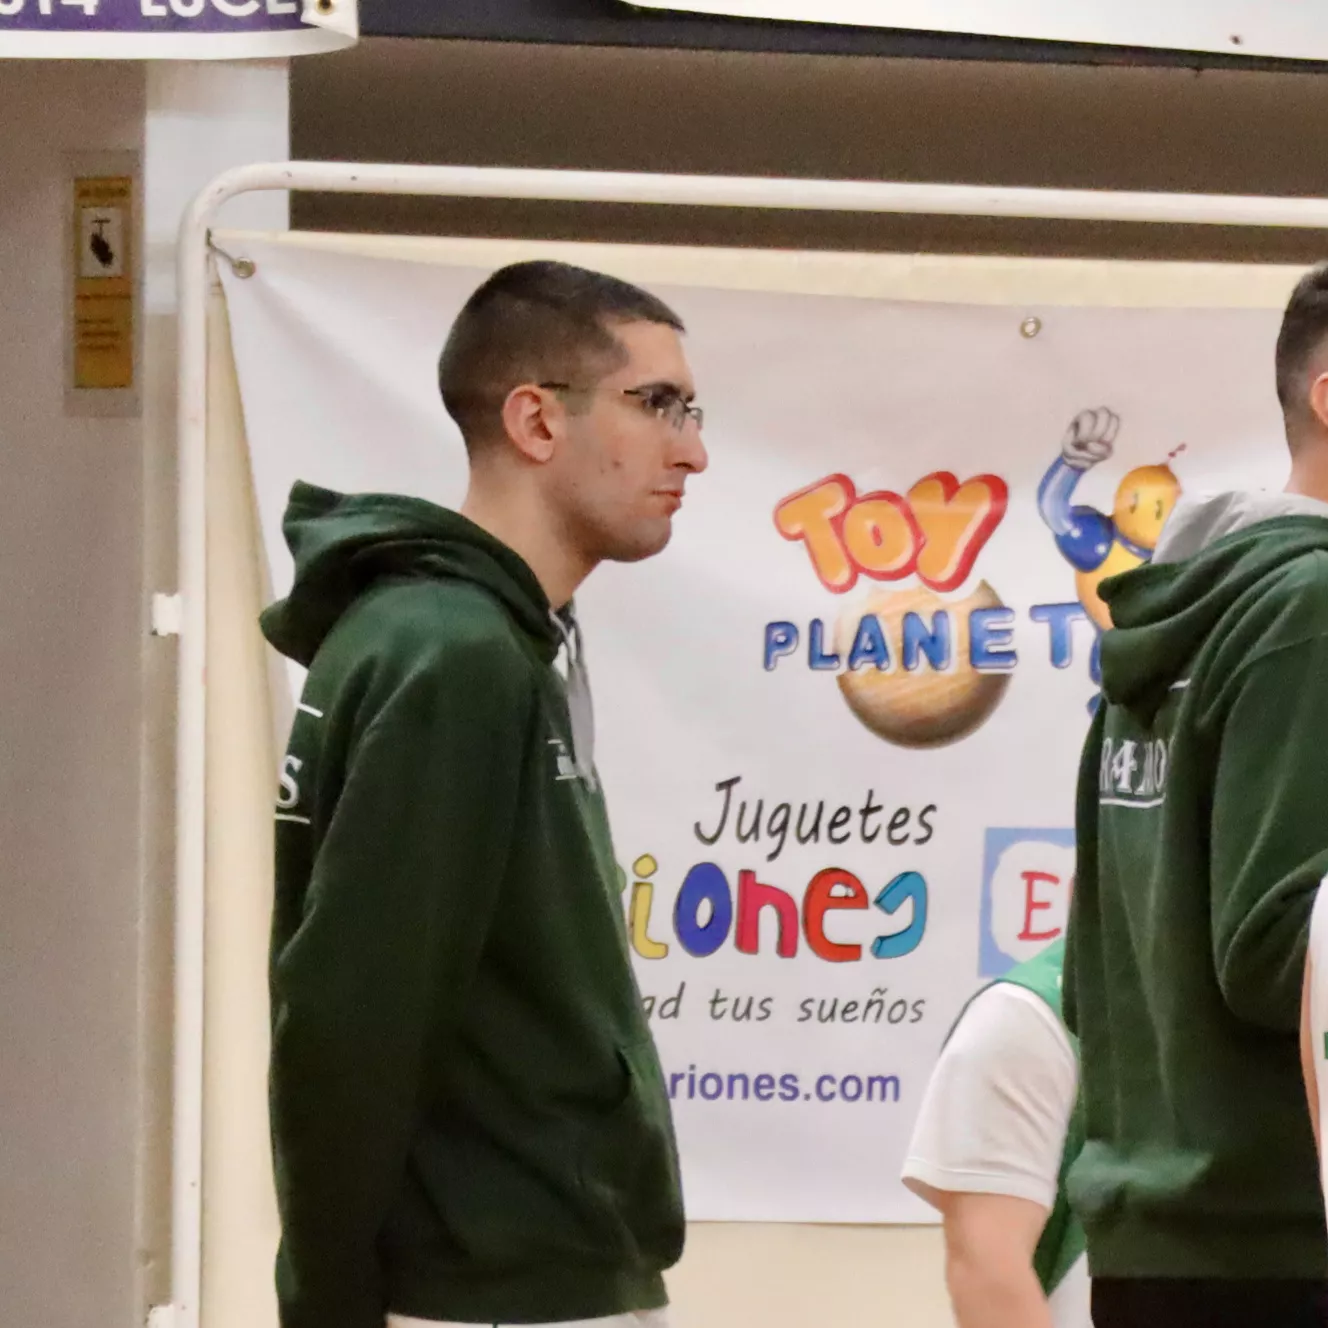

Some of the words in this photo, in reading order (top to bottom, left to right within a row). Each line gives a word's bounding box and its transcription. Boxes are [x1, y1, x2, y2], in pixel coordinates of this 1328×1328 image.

[141, 0, 298, 17] LUCE
[763, 603, 1087, 671] PLANET
[694, 776, 938, 863] Juguetes
[628, 853, 929, 963] iones
[1017, 869, 1070, 942] E
[642, 981, 685, 1021] ad
[709, 989, 773, 1022] tus
[797, 987, 926, 1024] sueños
[668, 1064, 901, 1102] riones.com
